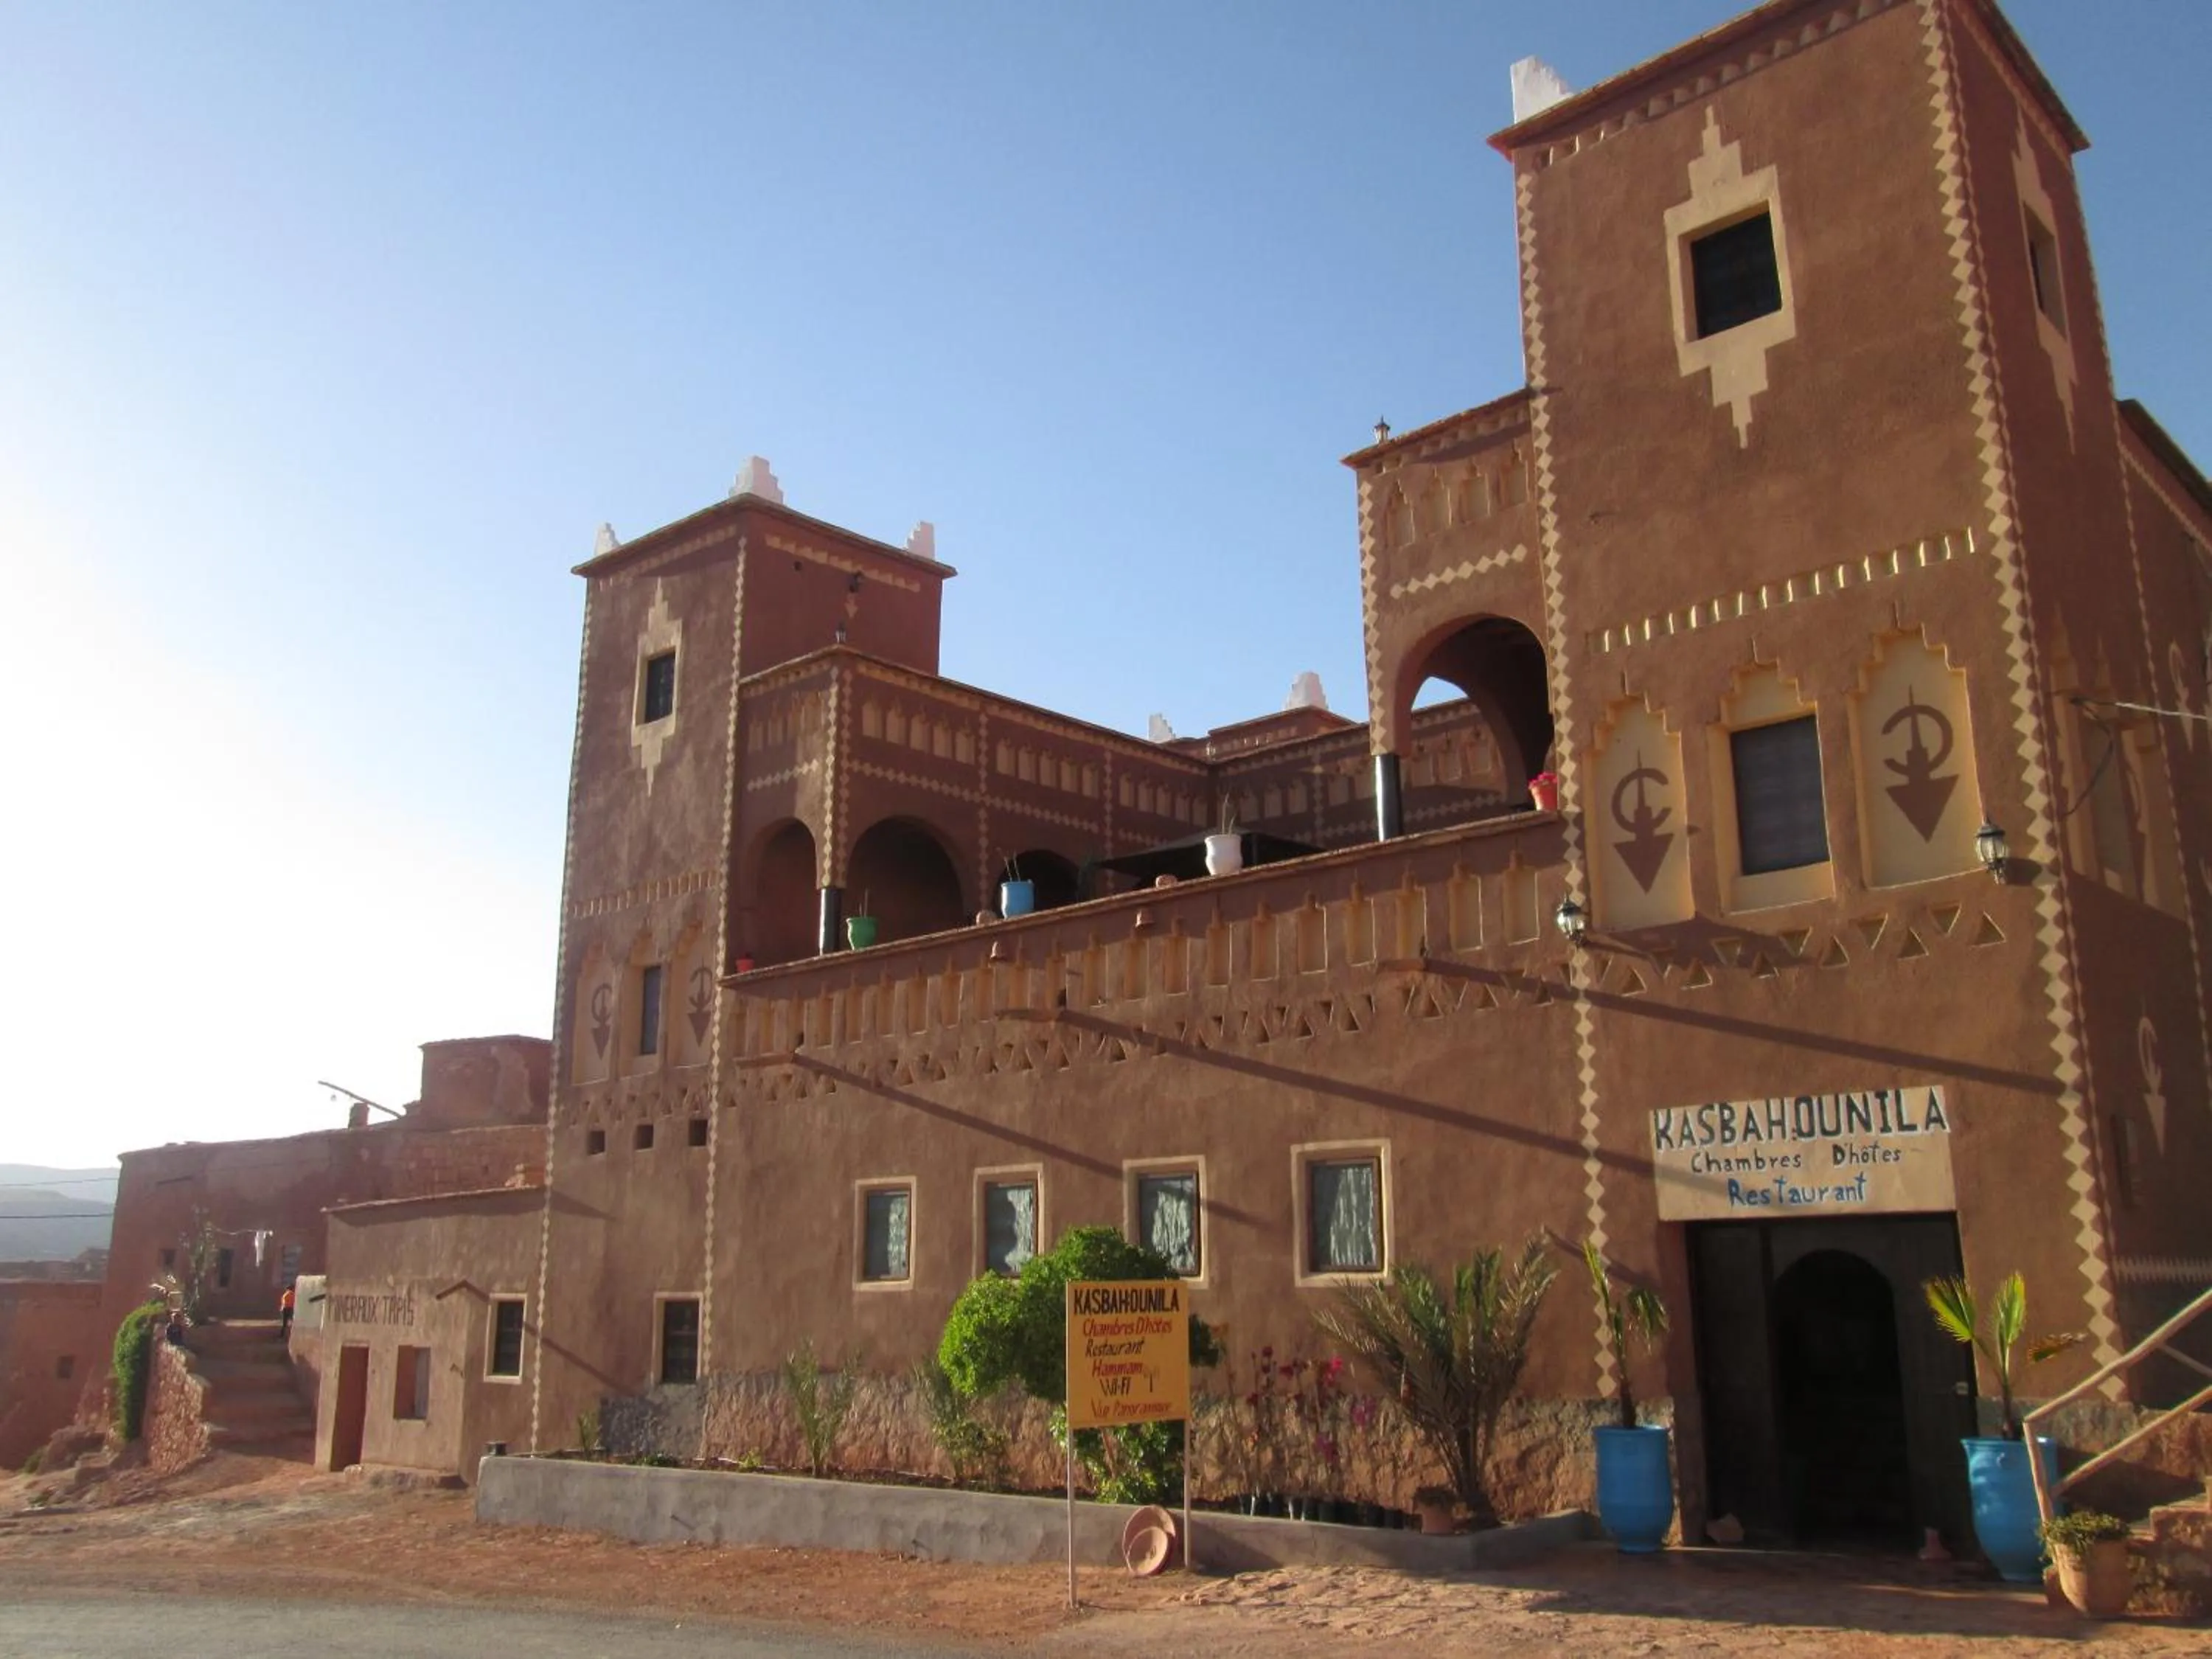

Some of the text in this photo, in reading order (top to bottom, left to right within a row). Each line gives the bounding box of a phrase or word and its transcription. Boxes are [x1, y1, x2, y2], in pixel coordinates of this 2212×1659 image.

[1691, 1147, 1802, 1173] Chambres
[1727, 1171, 1868, 1208] Restaurant
[1085, 1336, 1144, 1357] Restaurant
[1092, 1359, 1144, 1377] Hammam
